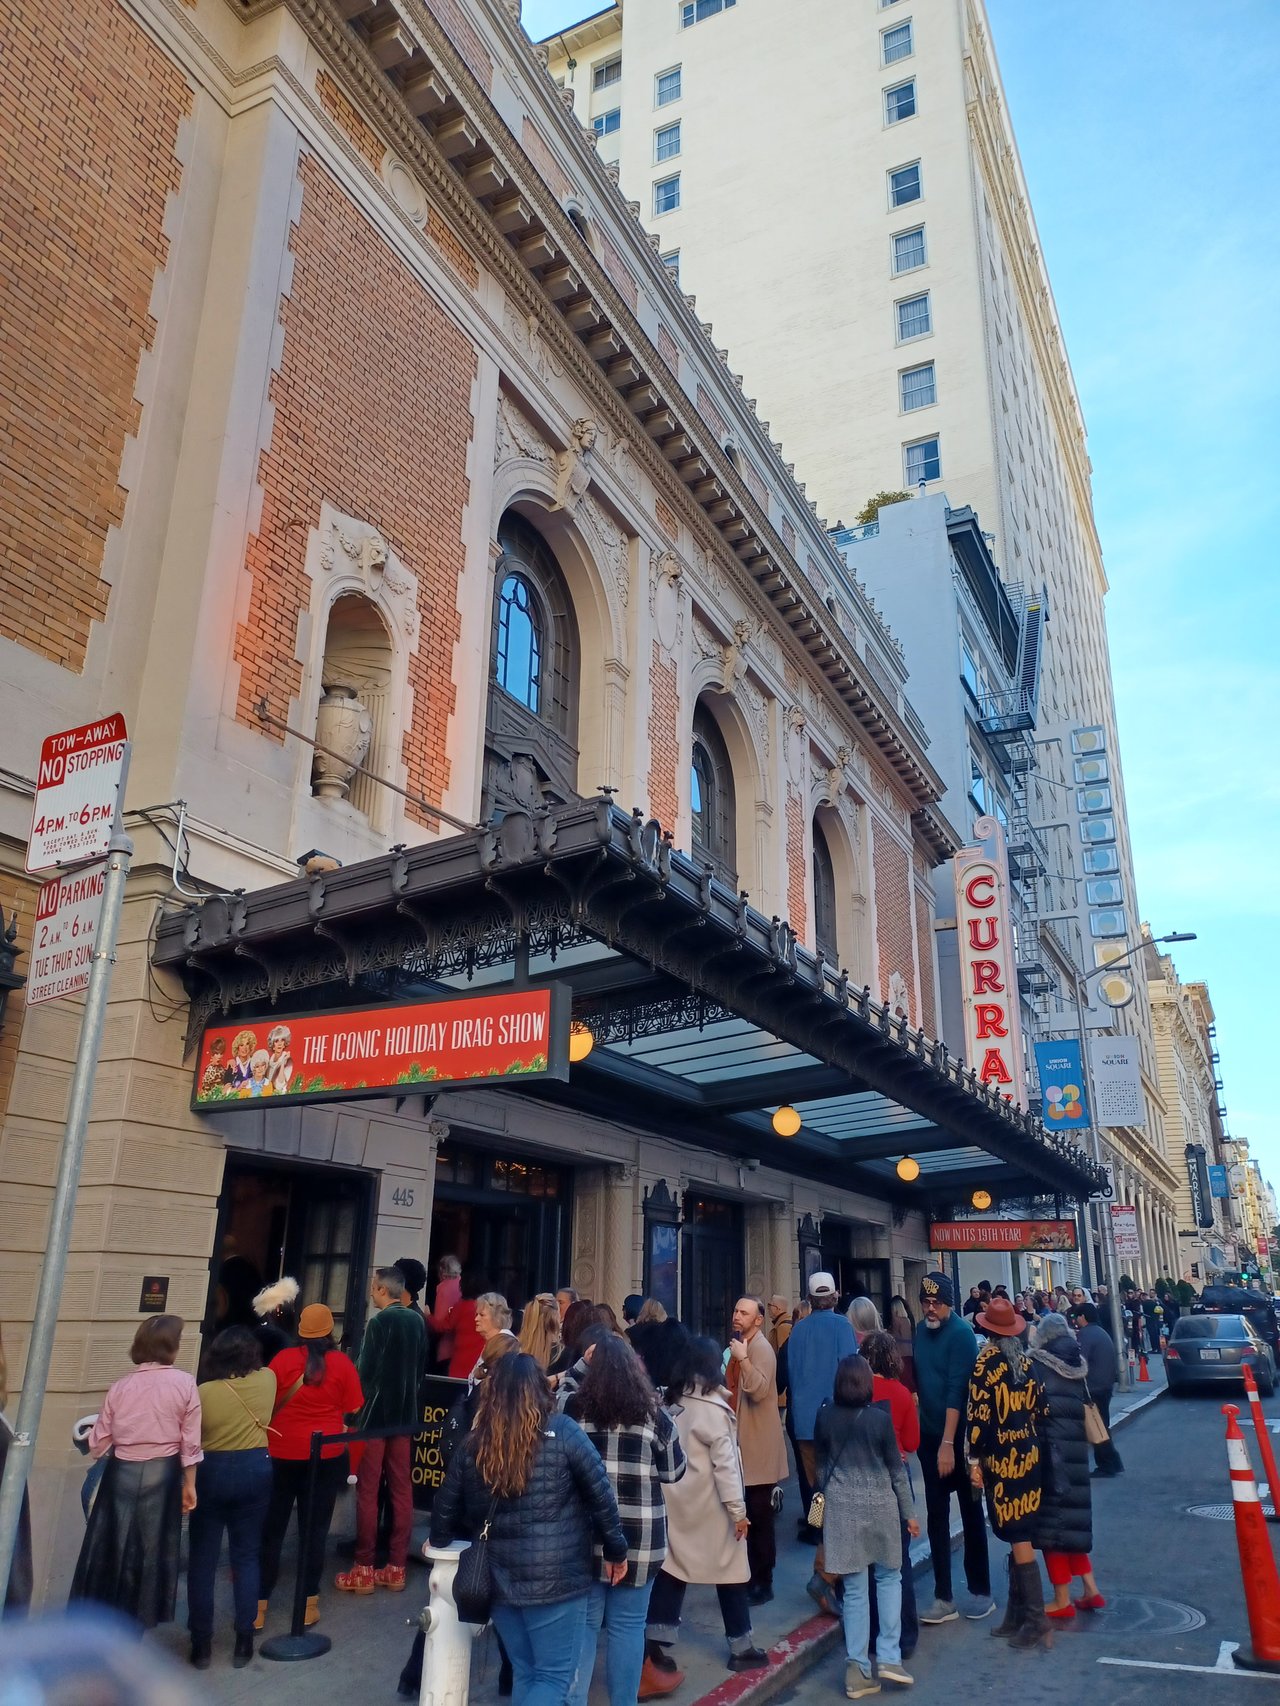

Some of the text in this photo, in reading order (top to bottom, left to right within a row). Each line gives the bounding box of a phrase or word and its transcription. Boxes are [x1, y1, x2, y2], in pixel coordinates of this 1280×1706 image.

[51, 720, 116, 754] TOW-AWAY
[40, 743, 123, 785] NO STOPPING
[69, 811, 79, 822] TO
[43, 837, 64, 846] EXCEPT
[43, 847, 62, 856] PHONE
[60, 839, 78, 847] TOWED
[81, 834, 96, 842] CARS
[38, 871, 105, 917] NO PARKING
[39, 925, 48, 948] 2
[72, 914, 79, 937] 6
[35, 943, 93, 979] TUE THUR SUN
[31, 971, 89, 1000] STREET CLEANING
[965, 874, 1014, 1101] CURRA
[303, 1010, 546, 1065] THE ICONIC HOLIDAY DRAG SHOW
[1045, 1062, 1072, 1071] SQUARE
[392, 1187, 414, 1207] 445
[1189, 1164, 1203, 1221] MARKER
[934, 1228, 1022, 1242] NOW IN ITS 19TH YEAR!
[423, 1406, 449, 1423] BO
